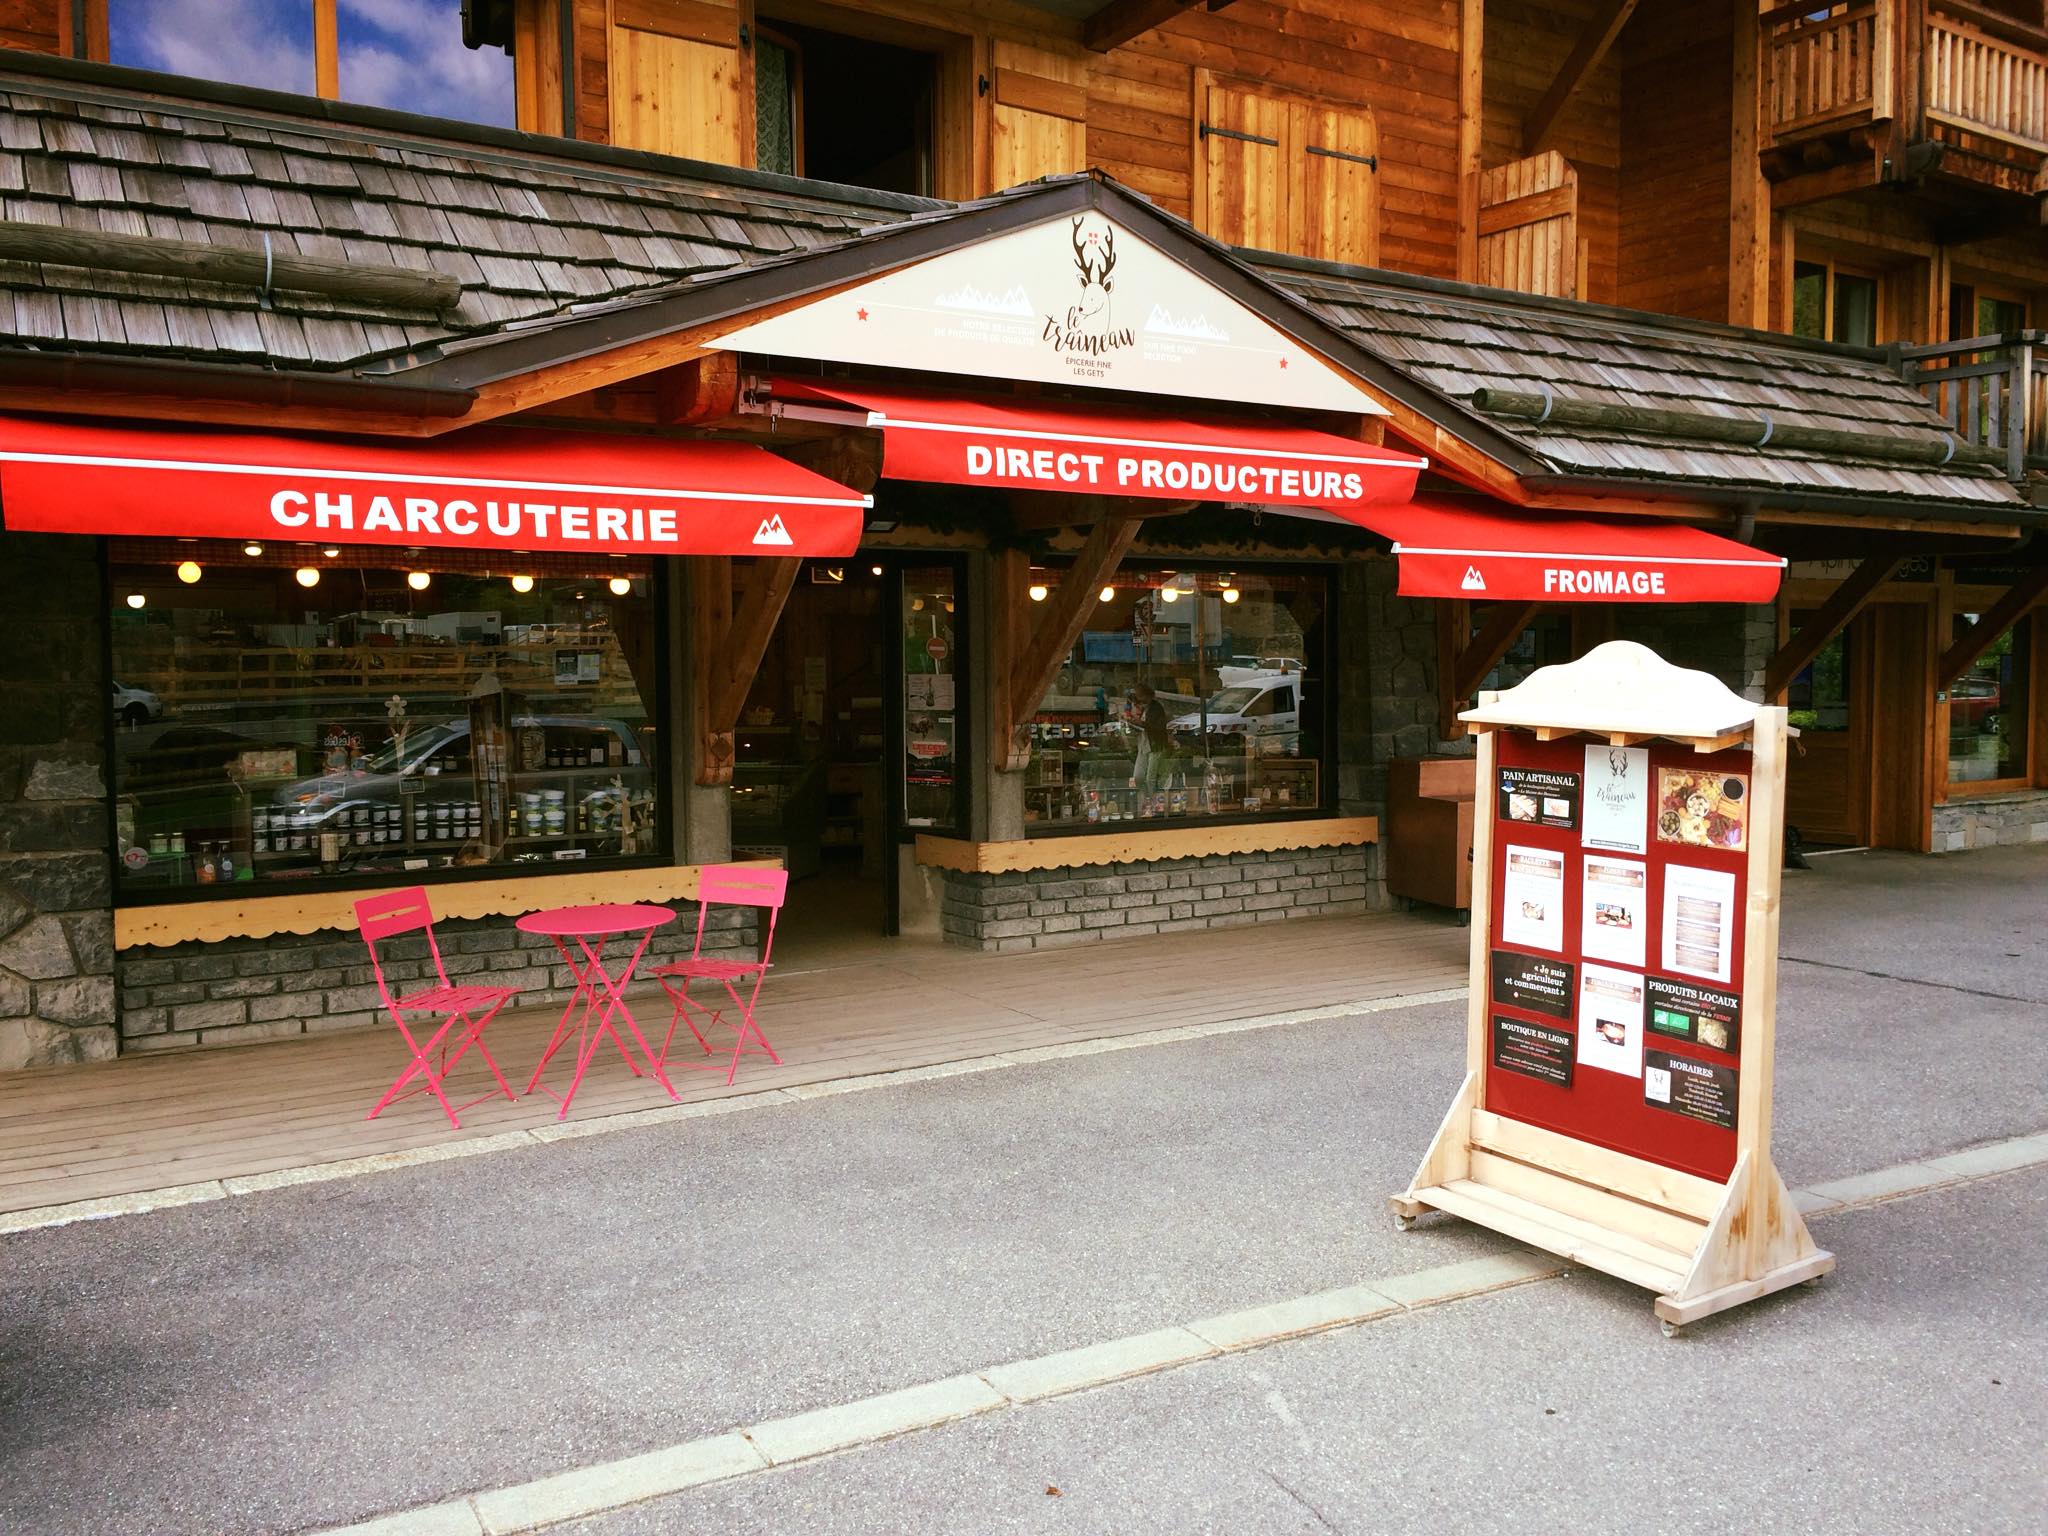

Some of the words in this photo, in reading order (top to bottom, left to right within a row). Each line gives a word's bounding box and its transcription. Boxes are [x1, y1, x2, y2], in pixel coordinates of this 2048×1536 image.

[1067, 305, 1079, 330] le
[1065, 356, 1095, 368] ÉPICERIE
[1096, 361, 1113, 370] FINE
[1073, 367, 1086, 377] LES
[1086, 369, 1105, 378] GETS
[966, 445, 1104, 485] DIRECT
[1117, 457, 1364, 500] PRODUCTEURS
[270, 489, 679, 543] CHARCUTERIE
[1544, 569, 1665, 595] FROMAGE
[1503, 770, 1525, 781] PAIN
[1525, 773, 1576, 787] ARTISANAL
[1521, 972, 1564, 987] agriculteur
[1539, 964, 1549, 974] Je
[1550, 968, 1567, 978] suis
[1504, 977, 1513, 985] et
[1513, 979, 1560, 996] commerçant
[1648, 981, 1698, 999] PRODUITS
[1698, 991, 1738, 1009] LOCAUX
[1501, 1022, 1537, 1038] BOUTIQUE
[1537, 1030, 1548, 1040] EN
[1548, 1033, 1569, 1046] LIGNE
[1669, 1060, 1714, 1078] HORAIRES
